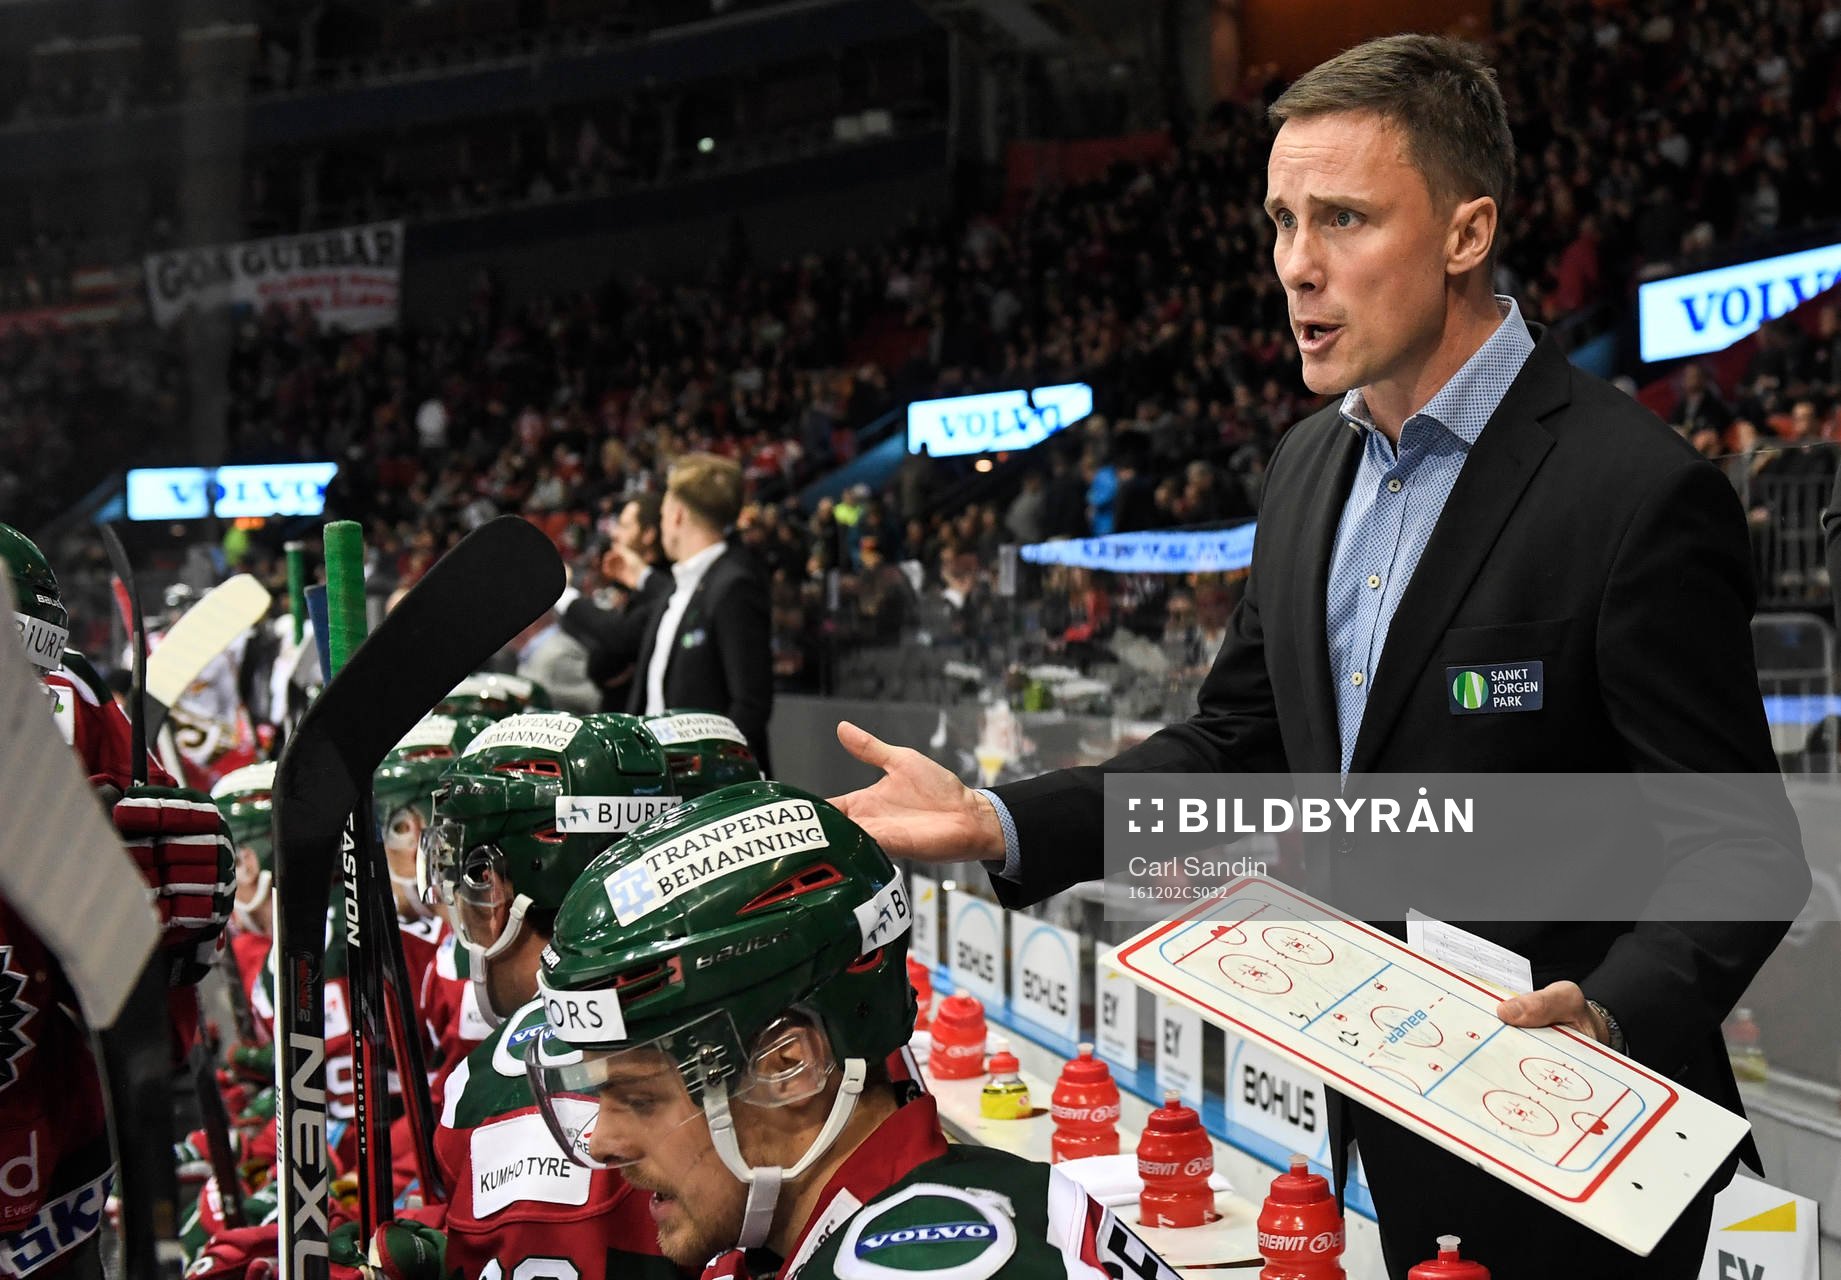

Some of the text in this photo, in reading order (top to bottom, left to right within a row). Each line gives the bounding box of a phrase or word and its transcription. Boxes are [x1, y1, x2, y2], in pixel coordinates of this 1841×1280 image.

[1680, 270, 1841, 332] VOLV
[939, 404, 1063, 438] VOLVO
[1491, 669, 1528, 681] SANKT
[1492, 681, 1538, 694] JÖRGEN
[1493, 696, 1522, 708] PARK
[645, 804, 815, 872] TRANPENAD
[656, 827, 824, 897] BEMANNING
[957, 940, 994, 984] BOHUS
[1023, 967, 1067, 1017] BOHUS
[1103, 991, 1119, 1028] EY
[545, 1000, 603, 1029] ORS
[1164, 1017, 1183, 1059] EY
[1243, 1064, 1316, 1133] BOHUS
[480, 1156, 571, 1193] KUMHO TYRE
[861, 1224, 991, 1248] VOLVO
[1259, 1231, 1308, 1252] ENERVIT
